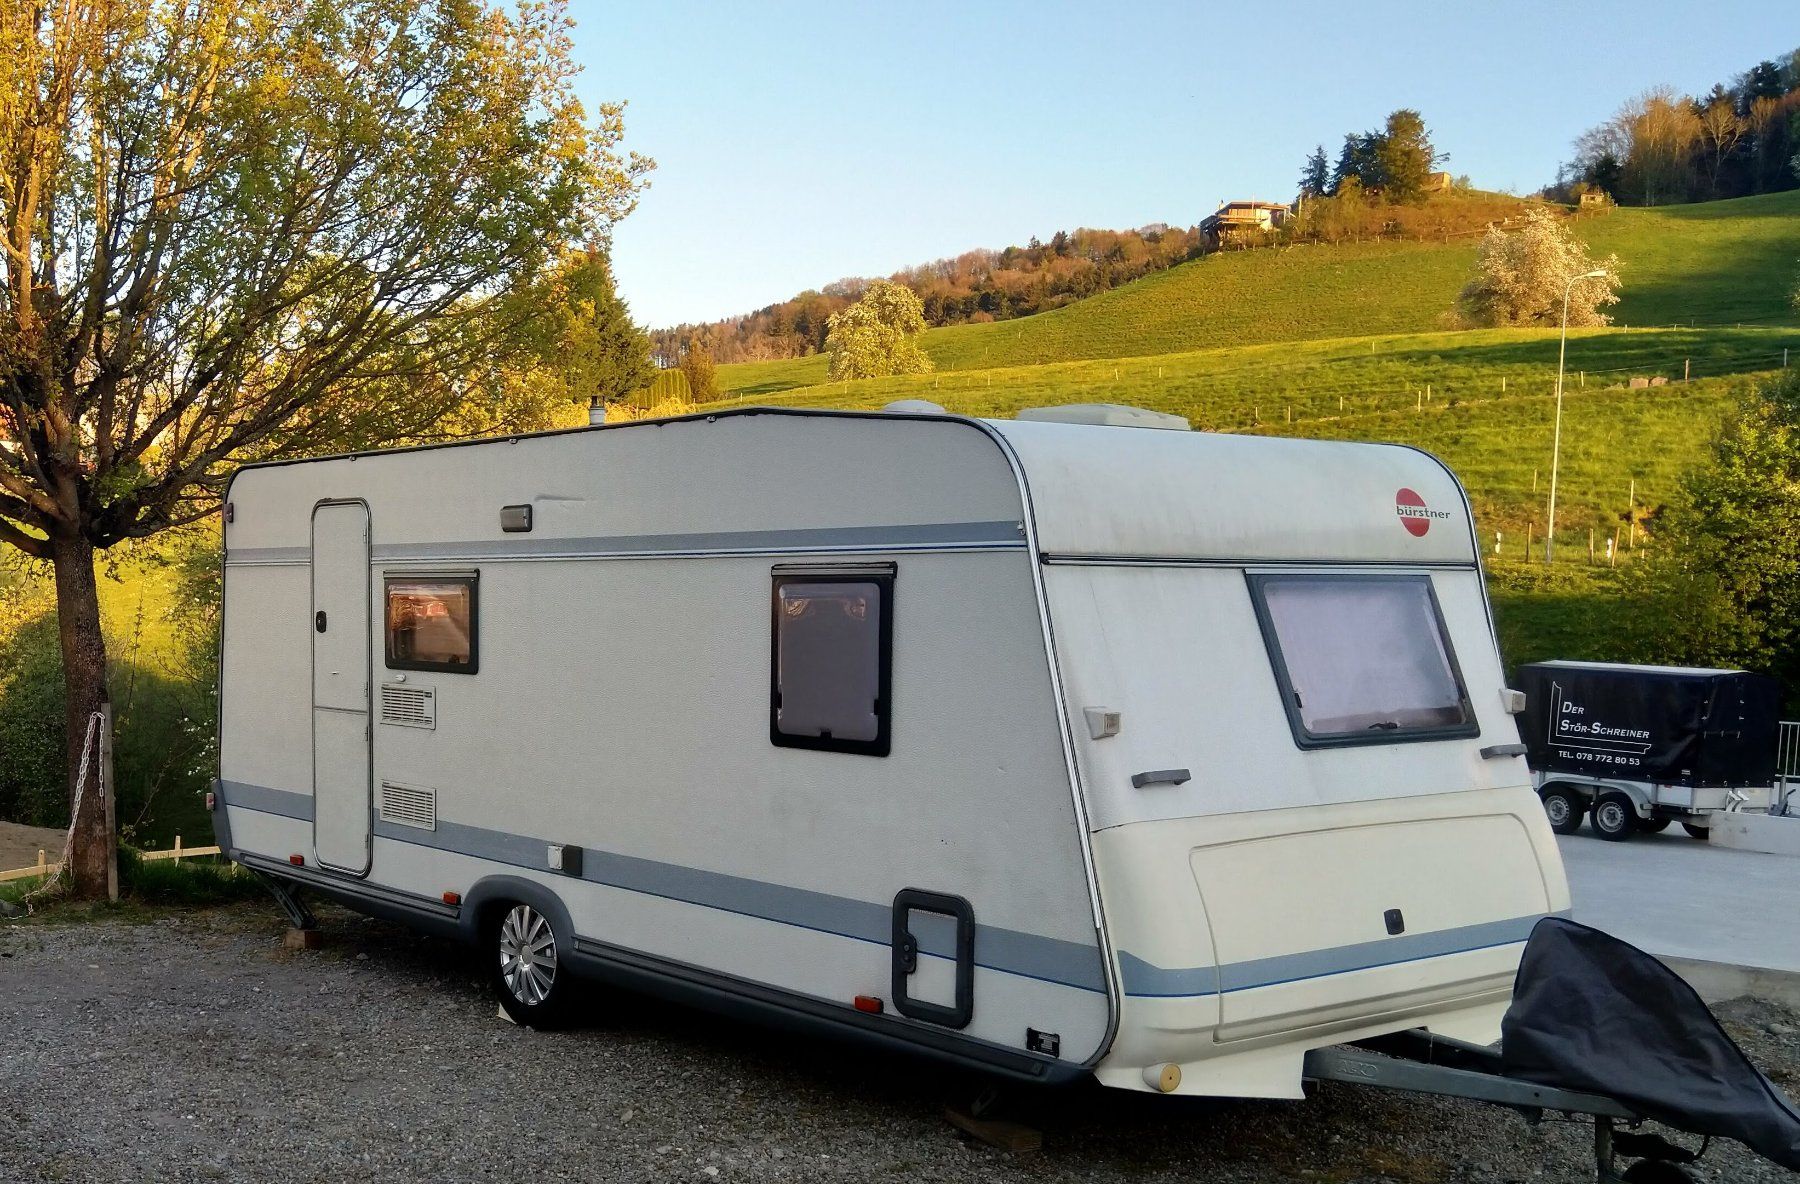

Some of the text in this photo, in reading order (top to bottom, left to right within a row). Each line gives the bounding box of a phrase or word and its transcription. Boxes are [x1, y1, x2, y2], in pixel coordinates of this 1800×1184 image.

[1396, 506, 1451, 519] bürstner
[1562, 701, 1585, 714] DER
[1560, 719, 1650, 739] STÖR-SCHREINER
[1558, 750, 1640, 766] TEL. 078 772 80 53
